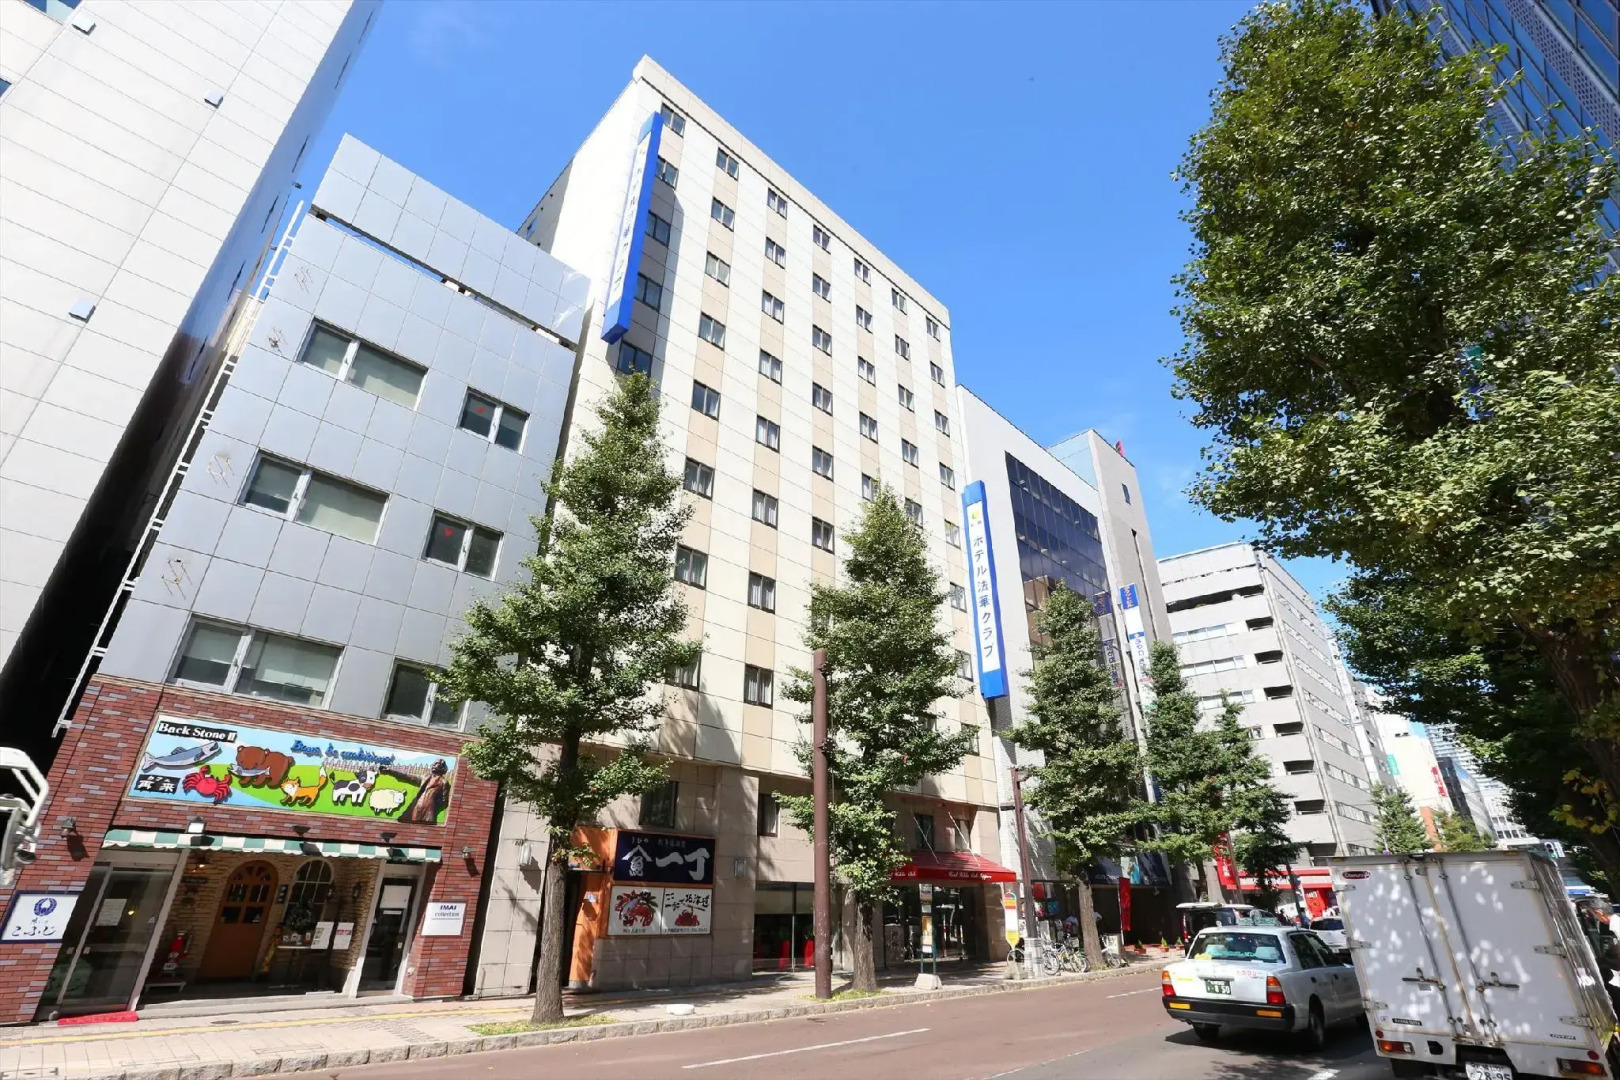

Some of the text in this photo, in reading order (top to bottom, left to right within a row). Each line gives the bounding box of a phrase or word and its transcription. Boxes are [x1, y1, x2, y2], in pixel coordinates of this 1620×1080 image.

[973, 535, 995, 658] ホテル法華クラブ
[158, 722, 190, 735] Back
[192, 728, 226, 740] Stone
